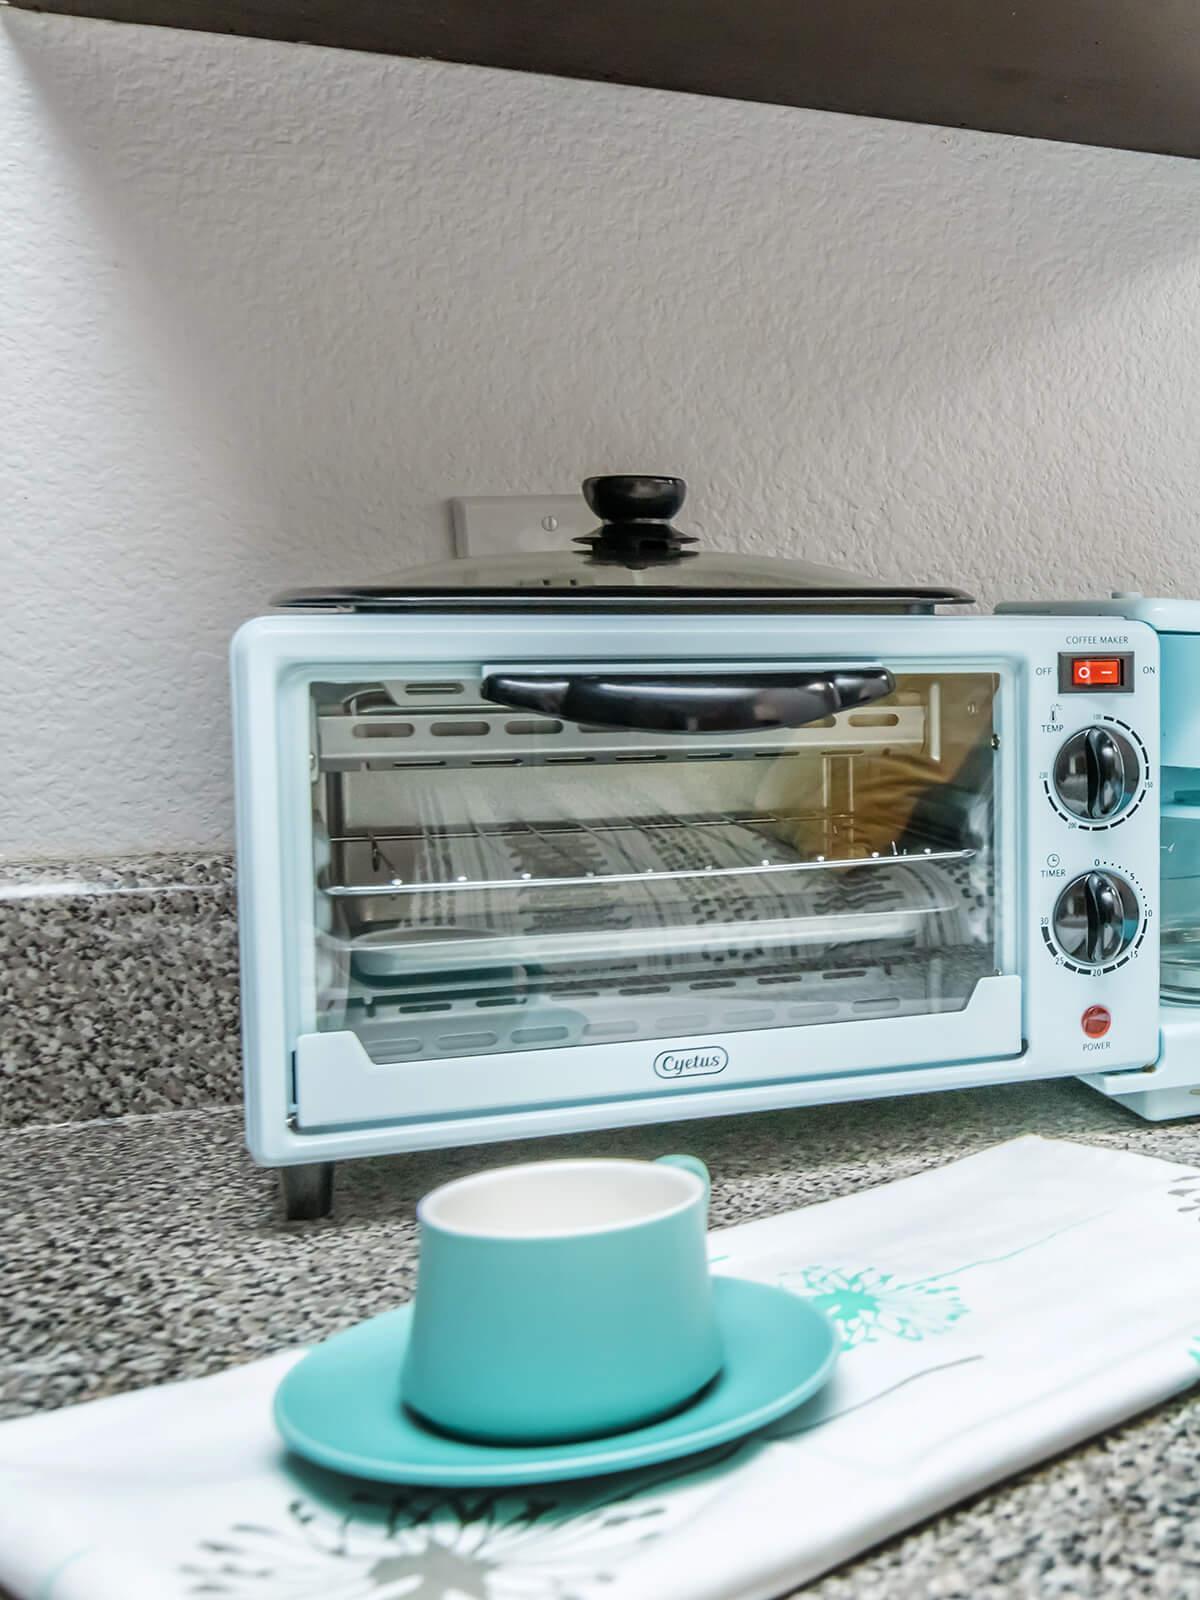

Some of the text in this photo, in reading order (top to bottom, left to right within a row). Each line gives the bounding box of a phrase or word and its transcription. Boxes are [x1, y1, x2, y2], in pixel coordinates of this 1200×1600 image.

[1065, 635, 1129, 645] COFFEE MAKER
[1035, 667, 1053, 676] OFF
[1142, 666, 1156, 675] ON
[1041, 724, 1064, 733] TEMP
[1093, 859, 1100, 867] 0
[1041, 868, 1066, 878] TIMER
[1129, 872, 1136, 881] 5
[1144, 909, 1153, 918] 10
[1040, 916, 1049, 926] 30
[1129, 950, 1139, 959] 15
[1055, 956, 1065, 966] 25
[1092, 968, 1102, 977] 20
[1082, 1041, 1111, 1052] POWER
